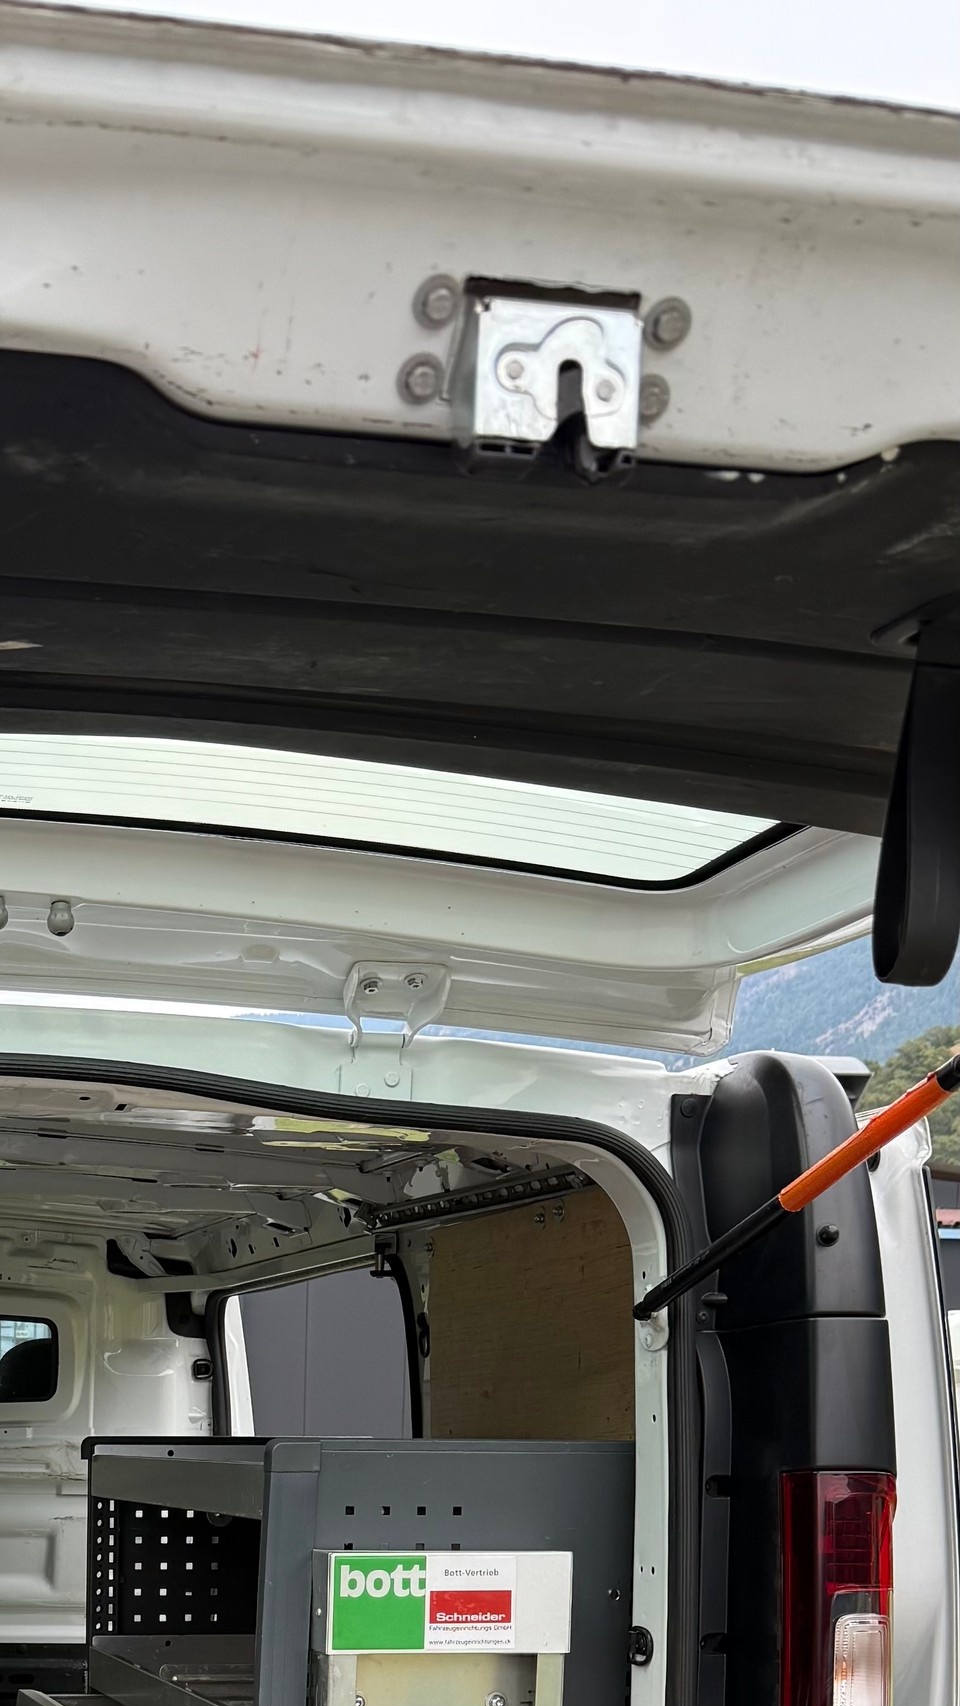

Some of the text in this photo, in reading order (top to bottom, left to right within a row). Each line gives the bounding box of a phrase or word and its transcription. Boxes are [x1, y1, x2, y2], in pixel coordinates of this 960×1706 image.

[444, 1568, 499, 1577] Bott-Vertrieb
[339, 1564, 426, 1598] bott
[436, 1612, 506, 1622] Schneider
